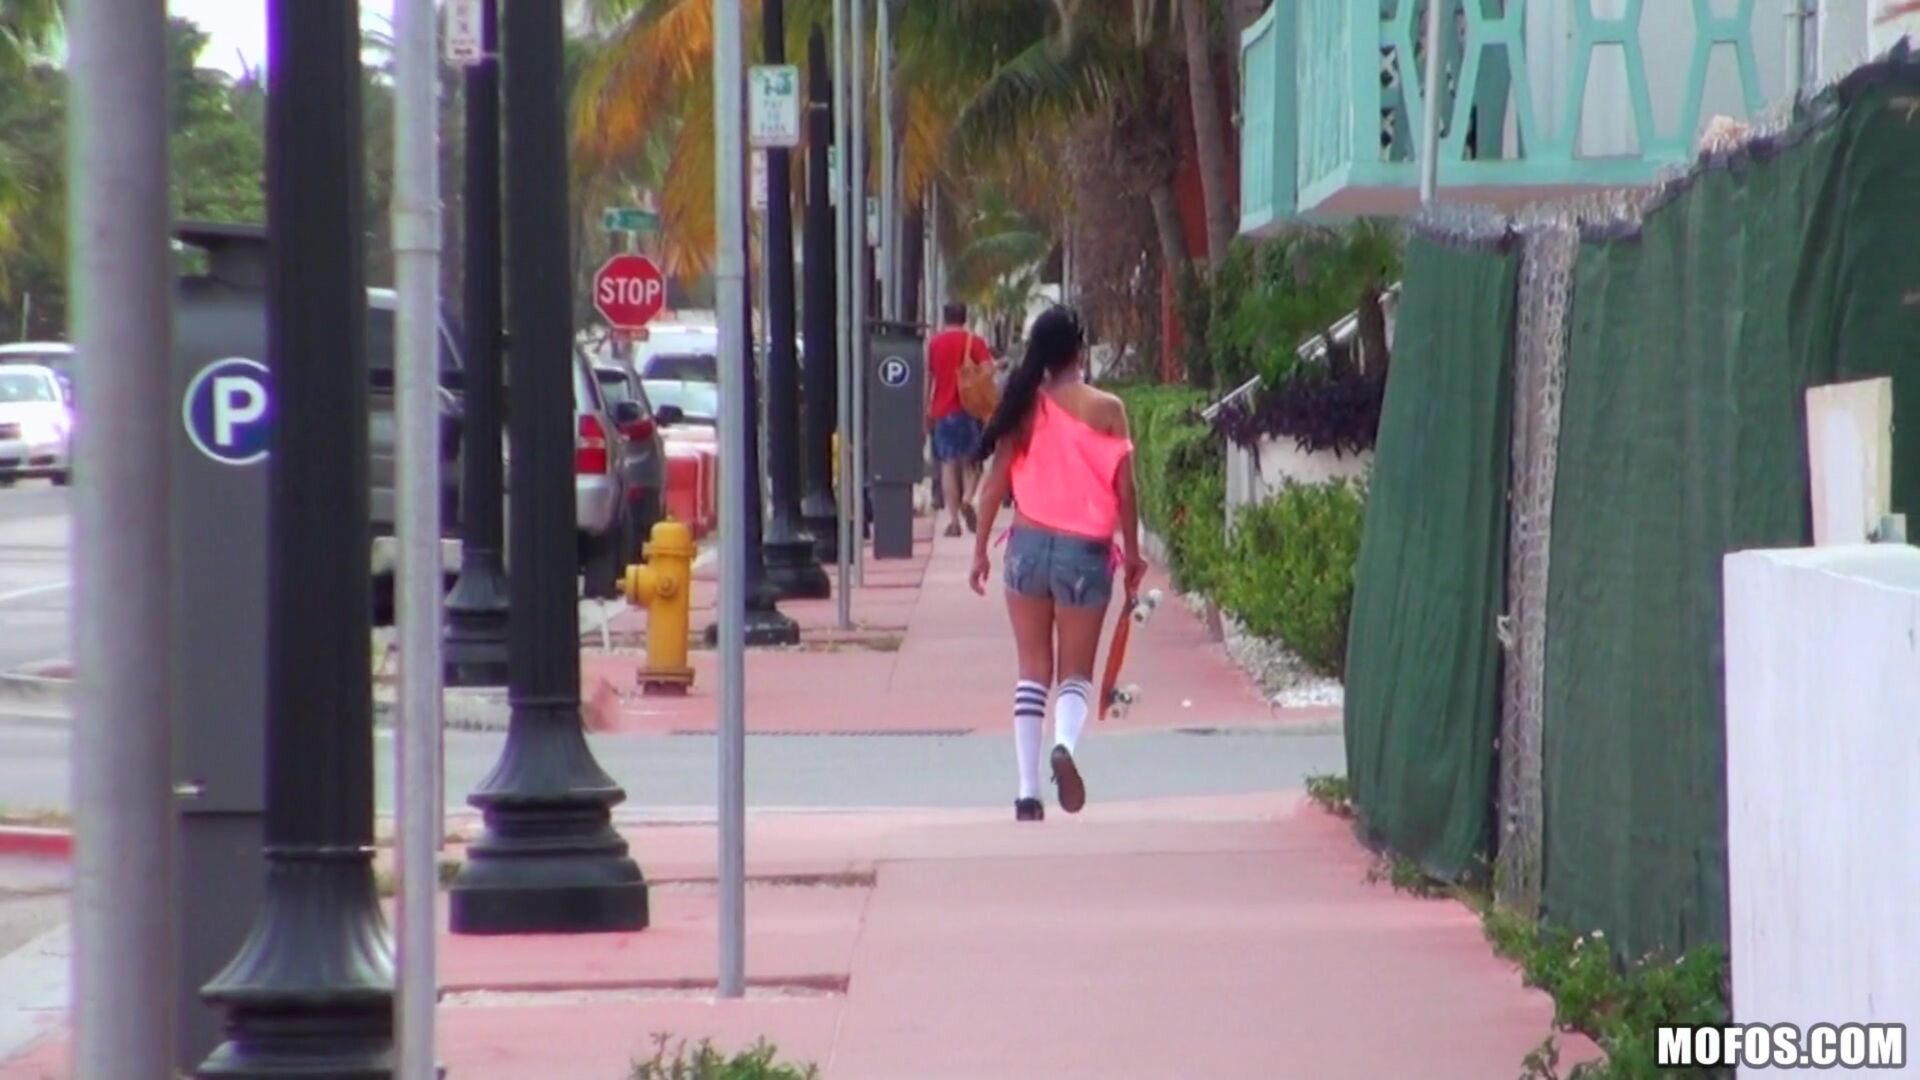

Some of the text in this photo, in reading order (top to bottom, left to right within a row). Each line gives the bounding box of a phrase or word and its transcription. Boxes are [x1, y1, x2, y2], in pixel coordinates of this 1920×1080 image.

[599, 277, 661, 305] STOP
[887, 361, 903, 382] P
[213, 376, 267, 446] P
